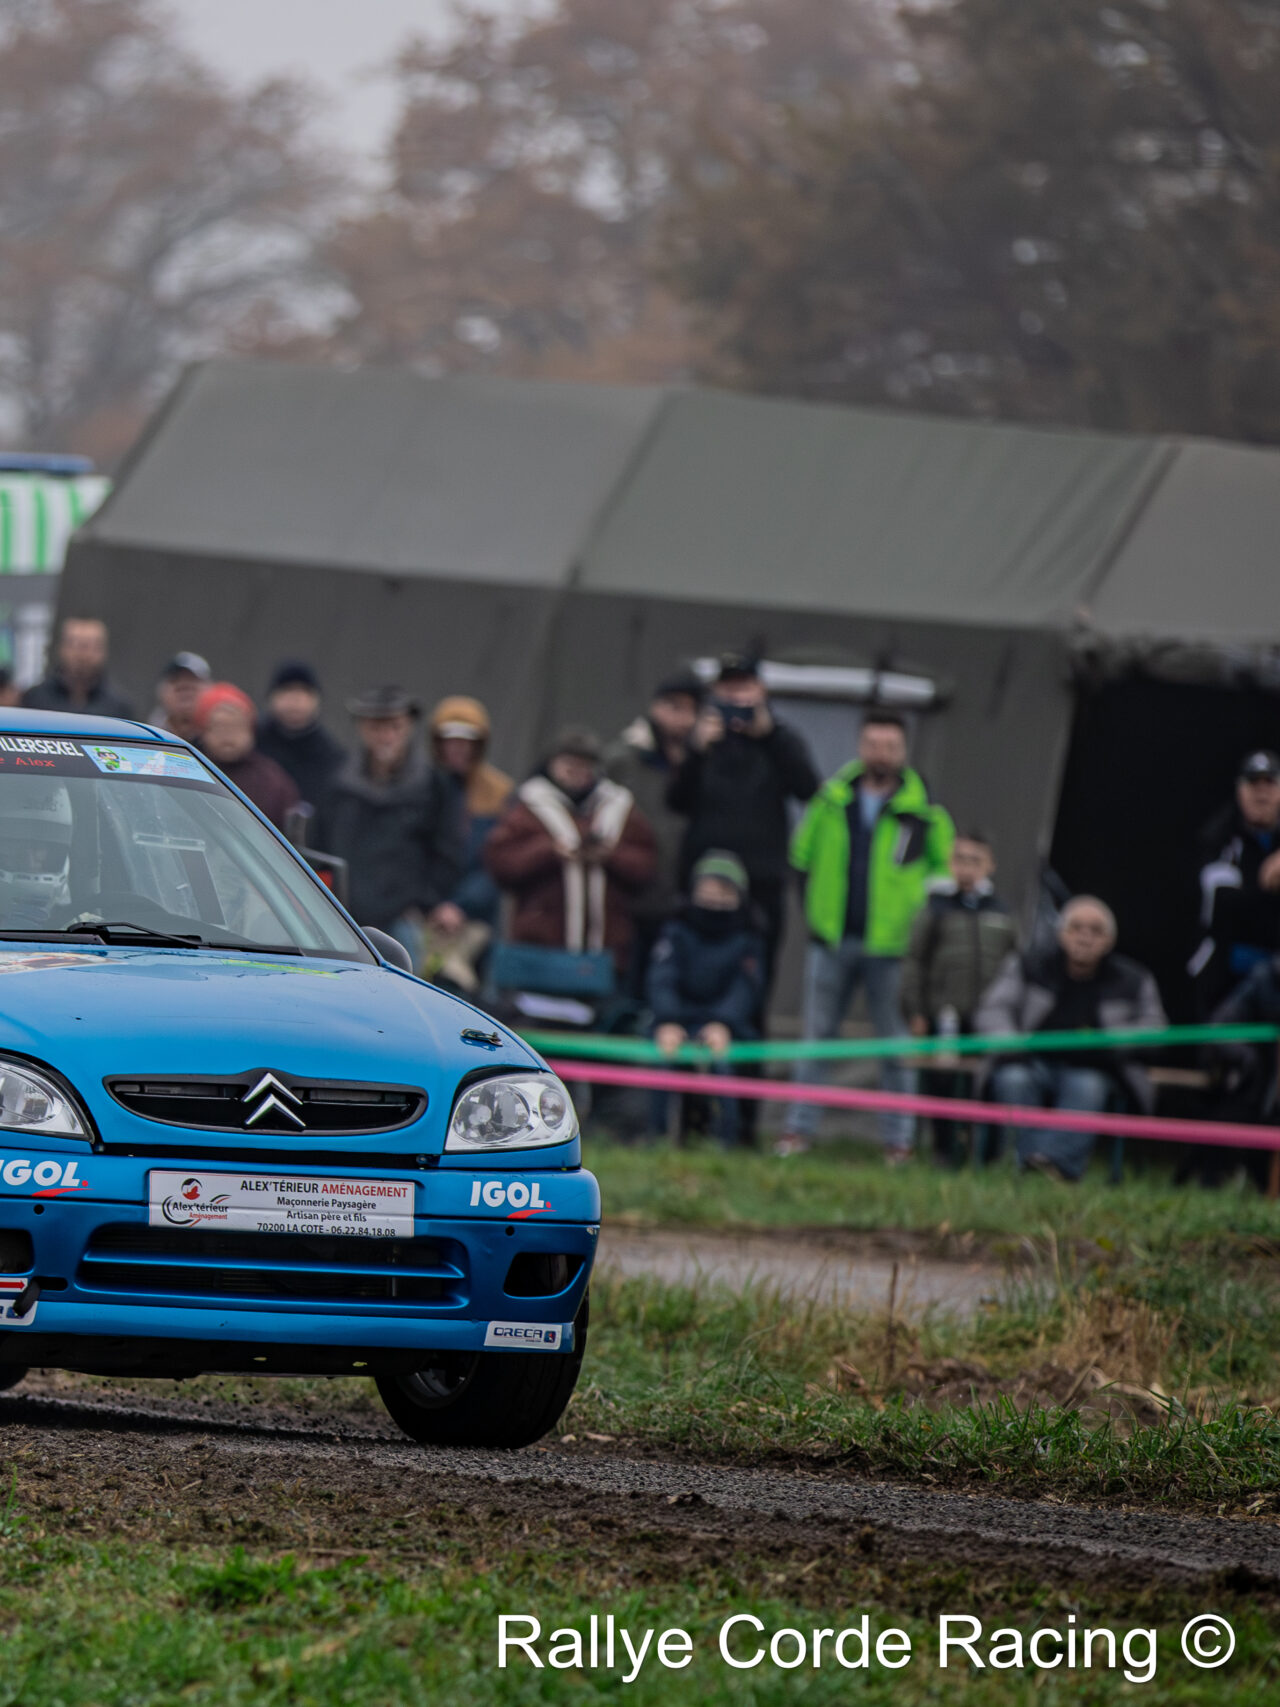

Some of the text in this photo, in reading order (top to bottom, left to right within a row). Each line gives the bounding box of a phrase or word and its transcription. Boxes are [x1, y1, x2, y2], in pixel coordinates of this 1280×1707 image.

[15, 757, 56, 767] Alex
[321, 1182, 408, 1198] AMÉNAGEMENT
[470, 1181, 545, 1208] IGOL
[277, 1196, 376, 1211] Maçonnerie Paysagère
[286, 1210, 367, 1222] Artisan père et fils
[257, 1223, 285, 1232] 70200
[287, 1224, 298, 1233] LA
[301, 1225, 324, 1234] COTE
[331, 1225, 396, 1237] 06.22.84.18.08
[494, 1327, 543, 1339] ORECA
